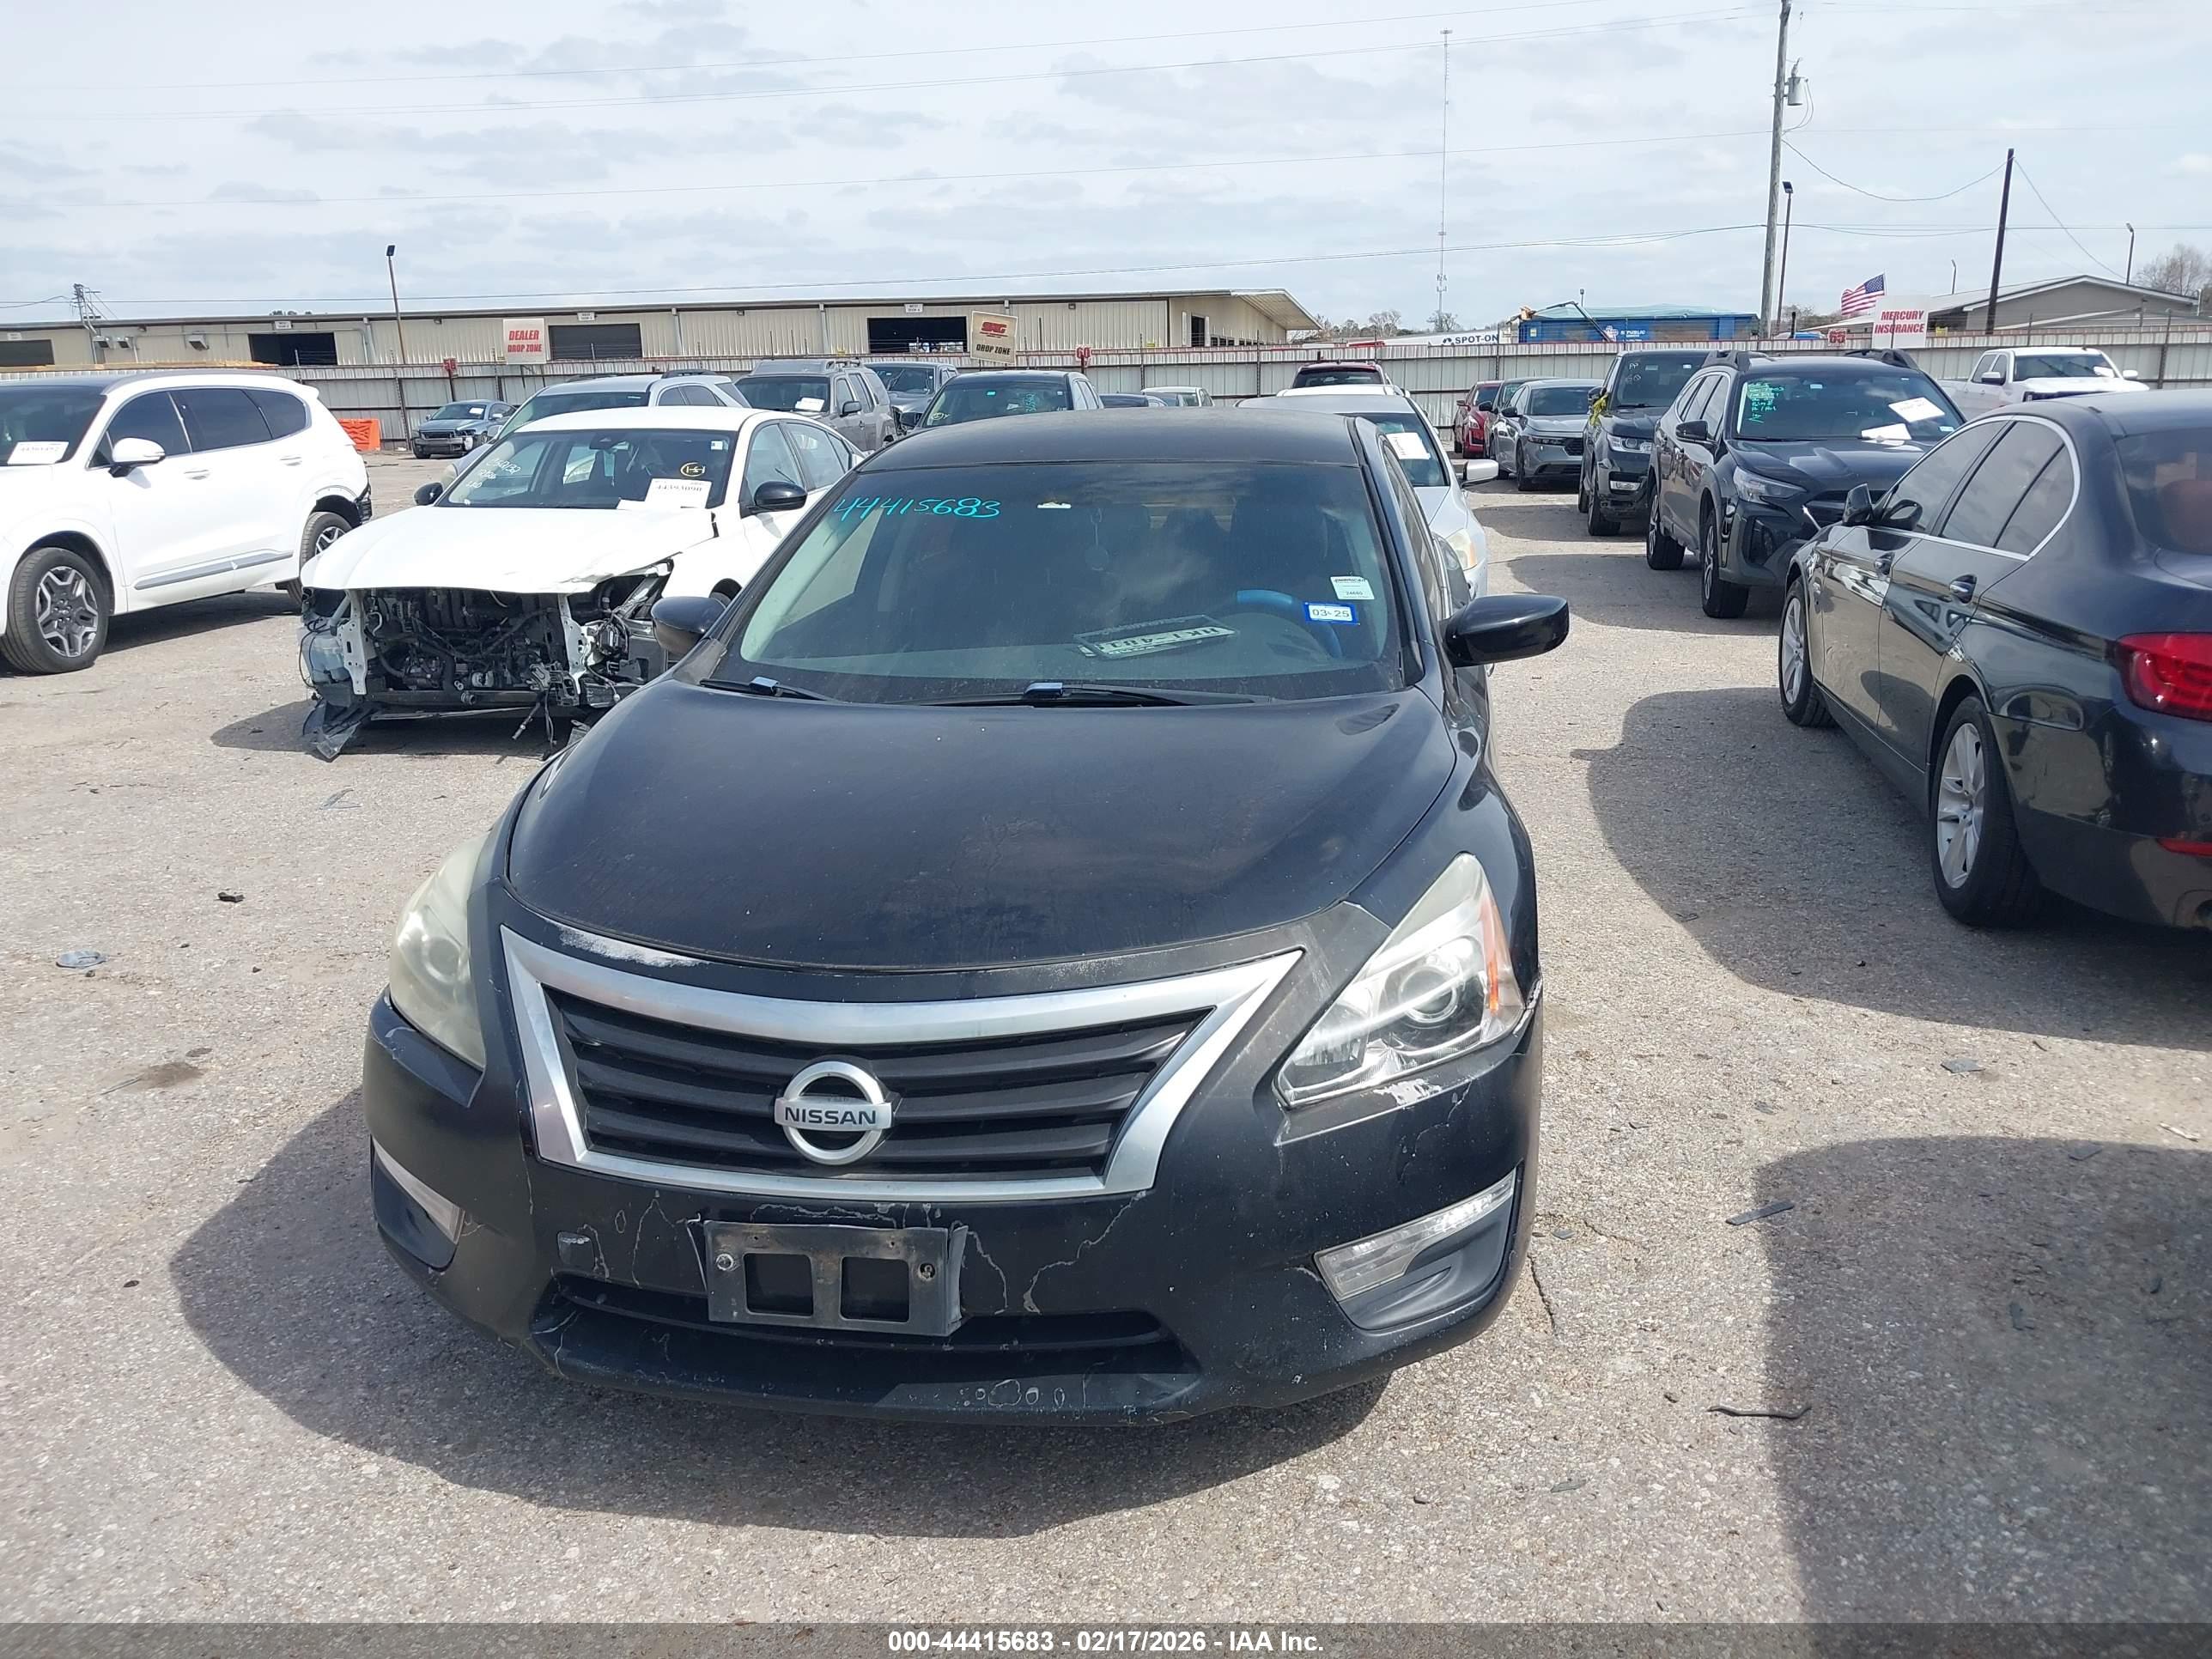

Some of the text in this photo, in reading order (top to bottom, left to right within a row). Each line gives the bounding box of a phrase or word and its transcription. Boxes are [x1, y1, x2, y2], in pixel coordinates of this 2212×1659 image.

[1881, 310, 1924, 321] MERCURY
[1874, 323, 1925, 334] INSURANCE
[508, 330, 539, 341] DEALER
[1455, 334, 1499, 344] SPOT-ON
[507, 343, 543, 353] DROP ZONE
[975, 343, 1011, 355] DROP ZONE
[1076, 346, 1091, 359] 60
[833, 497, 1001, 521] 44415683
[785, 1107, 876, 1125] NISSAN
